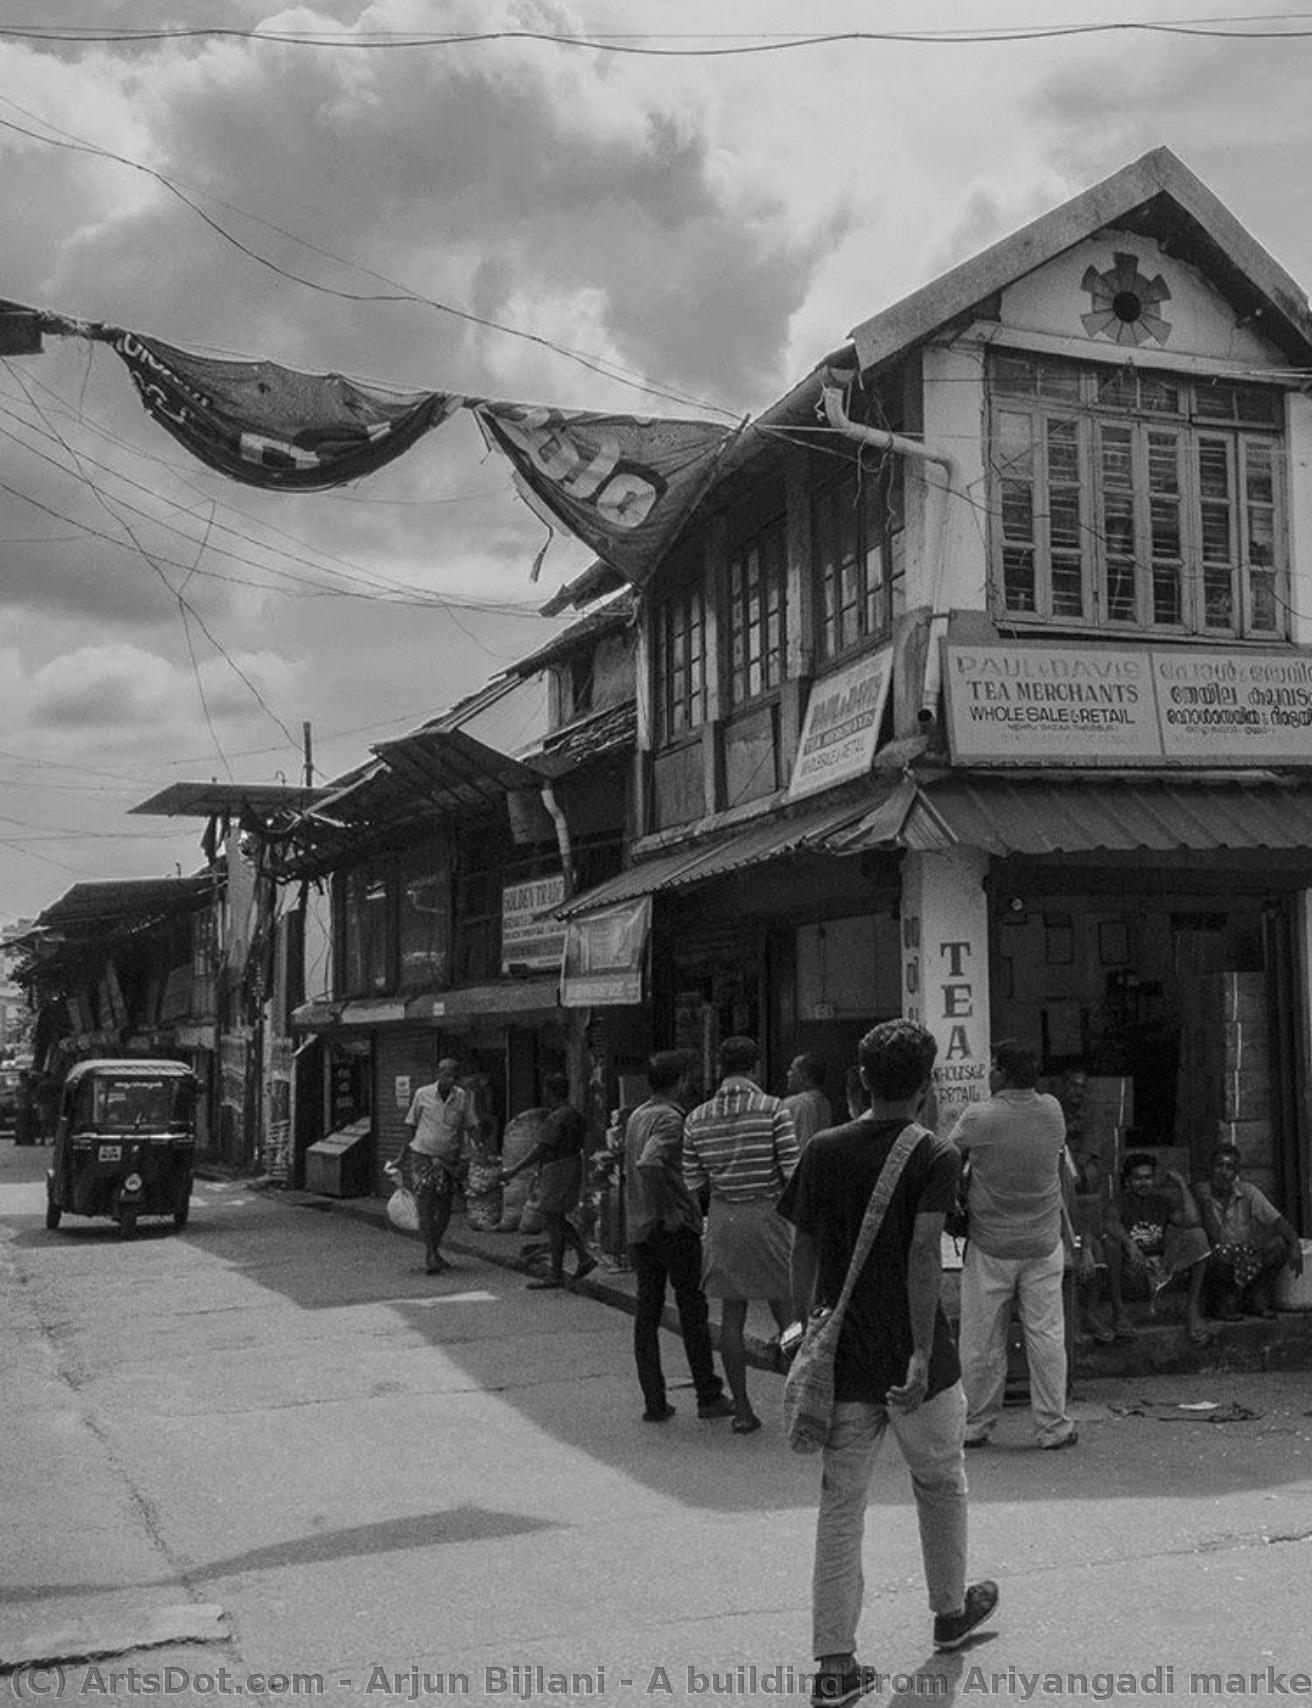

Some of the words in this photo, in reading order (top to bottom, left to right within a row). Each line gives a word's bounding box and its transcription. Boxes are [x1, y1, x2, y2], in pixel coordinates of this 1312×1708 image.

[957, 655, 1035, 678] PAUL
[1050, 659, 1141, 680] DAVIS
[966, 680, 1010, 701] TEA
[1016, 681, 1139, 703] MERCHANTS
[1170, 682, 1238, 705] തേയില
[970, 705, 1069, 722] WHOLESALE
[1080, 707, 1135, 724] RETAIL
[939, 941, 973, 1061] TEA
[938, 1085, 981, 1104] RETAIL
